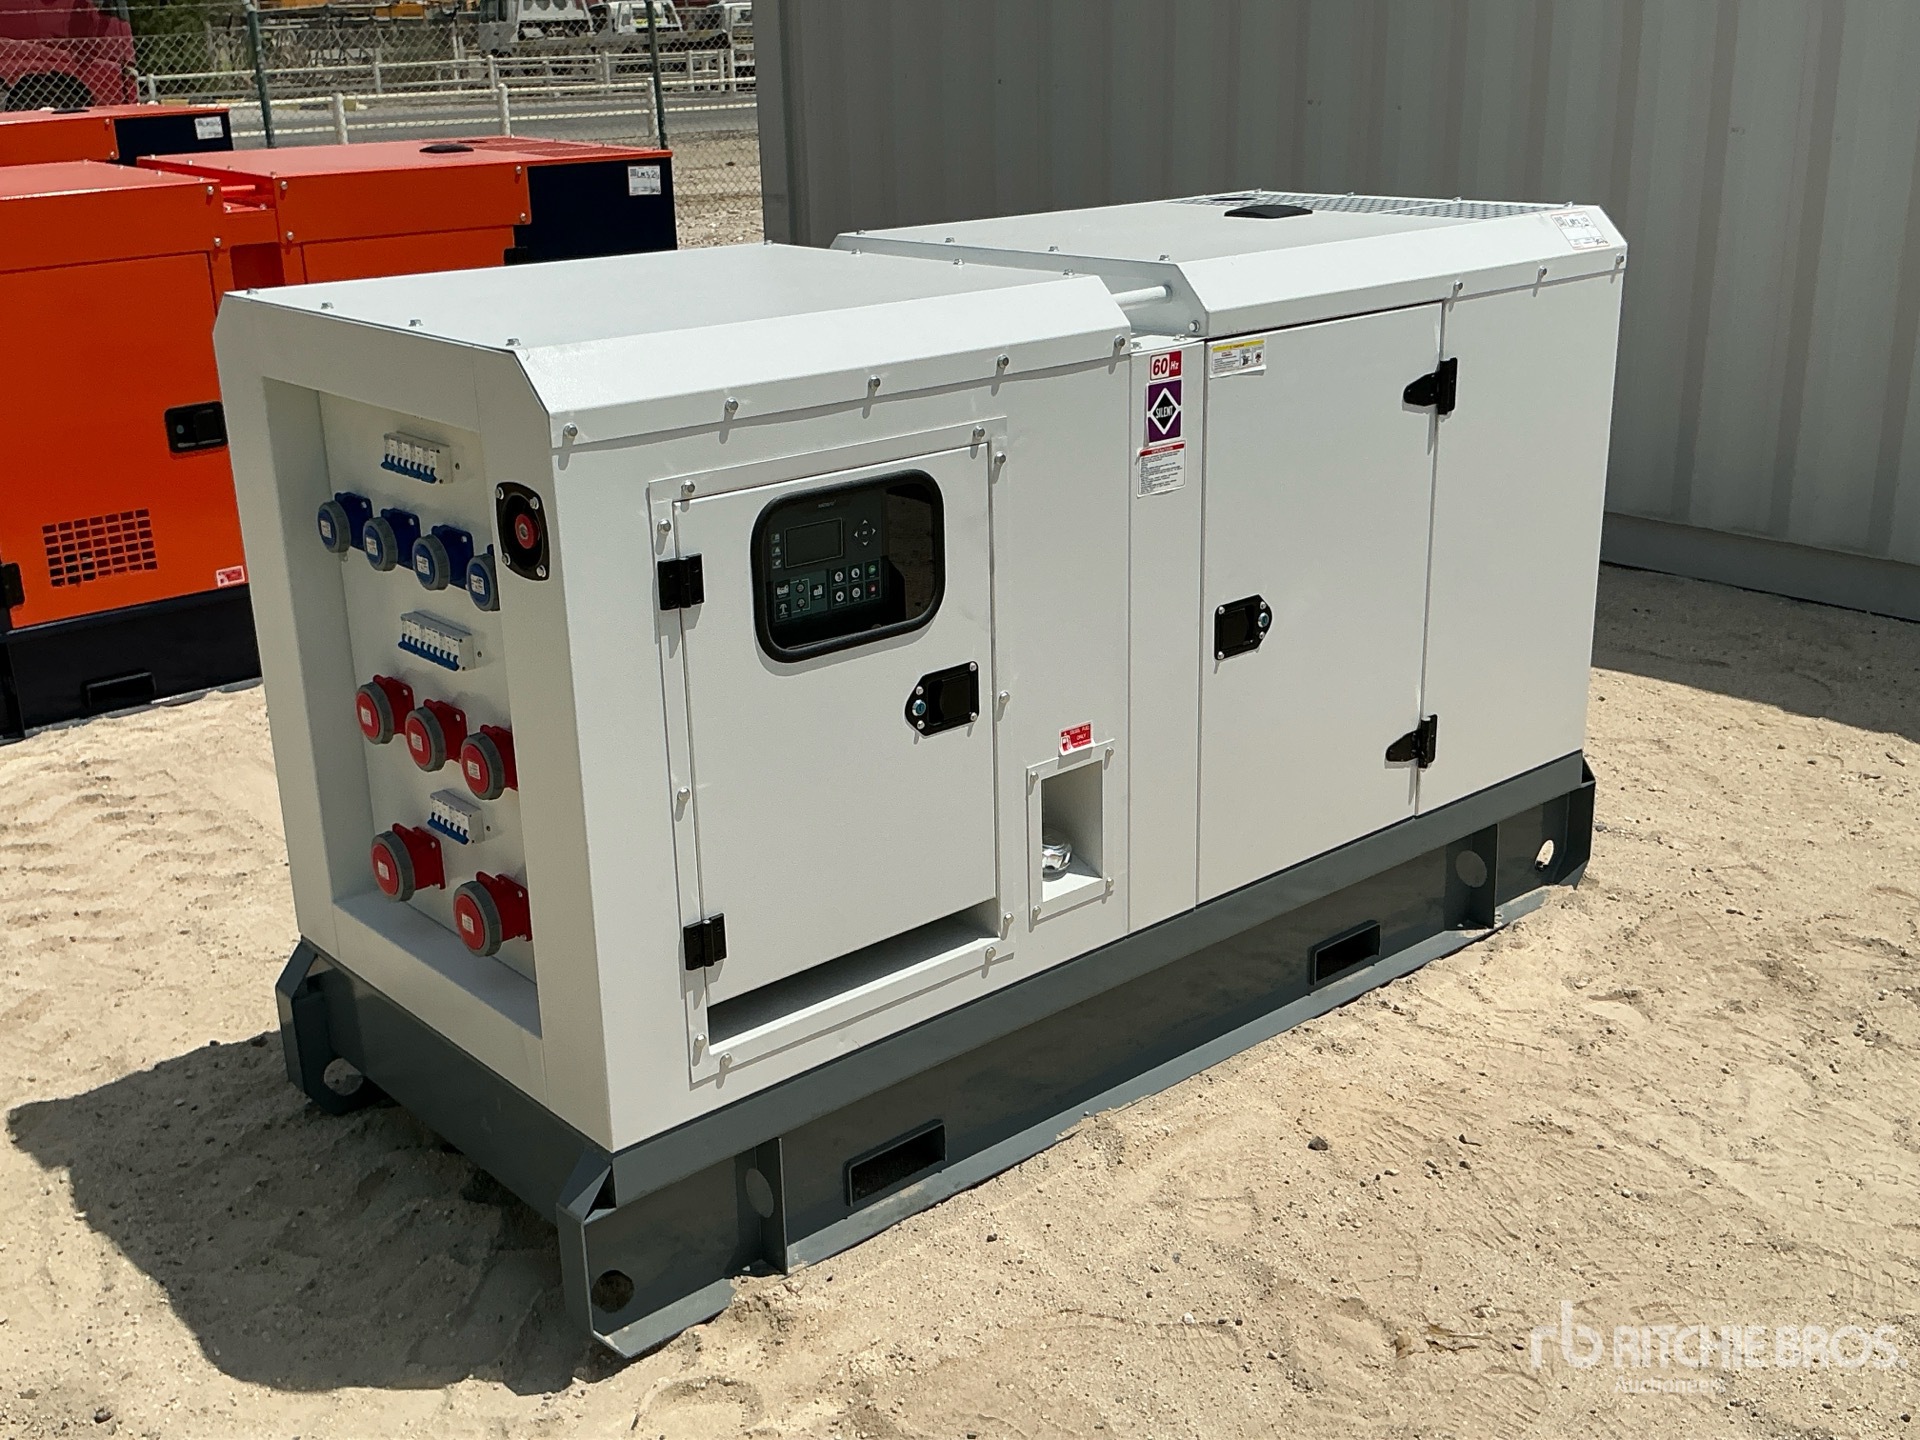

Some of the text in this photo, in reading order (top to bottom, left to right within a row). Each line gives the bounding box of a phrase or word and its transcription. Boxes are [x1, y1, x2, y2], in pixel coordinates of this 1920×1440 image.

[1153, 357, 1179, 376] 60 Hz
[1155, 405, 1173, 419] SILENT
